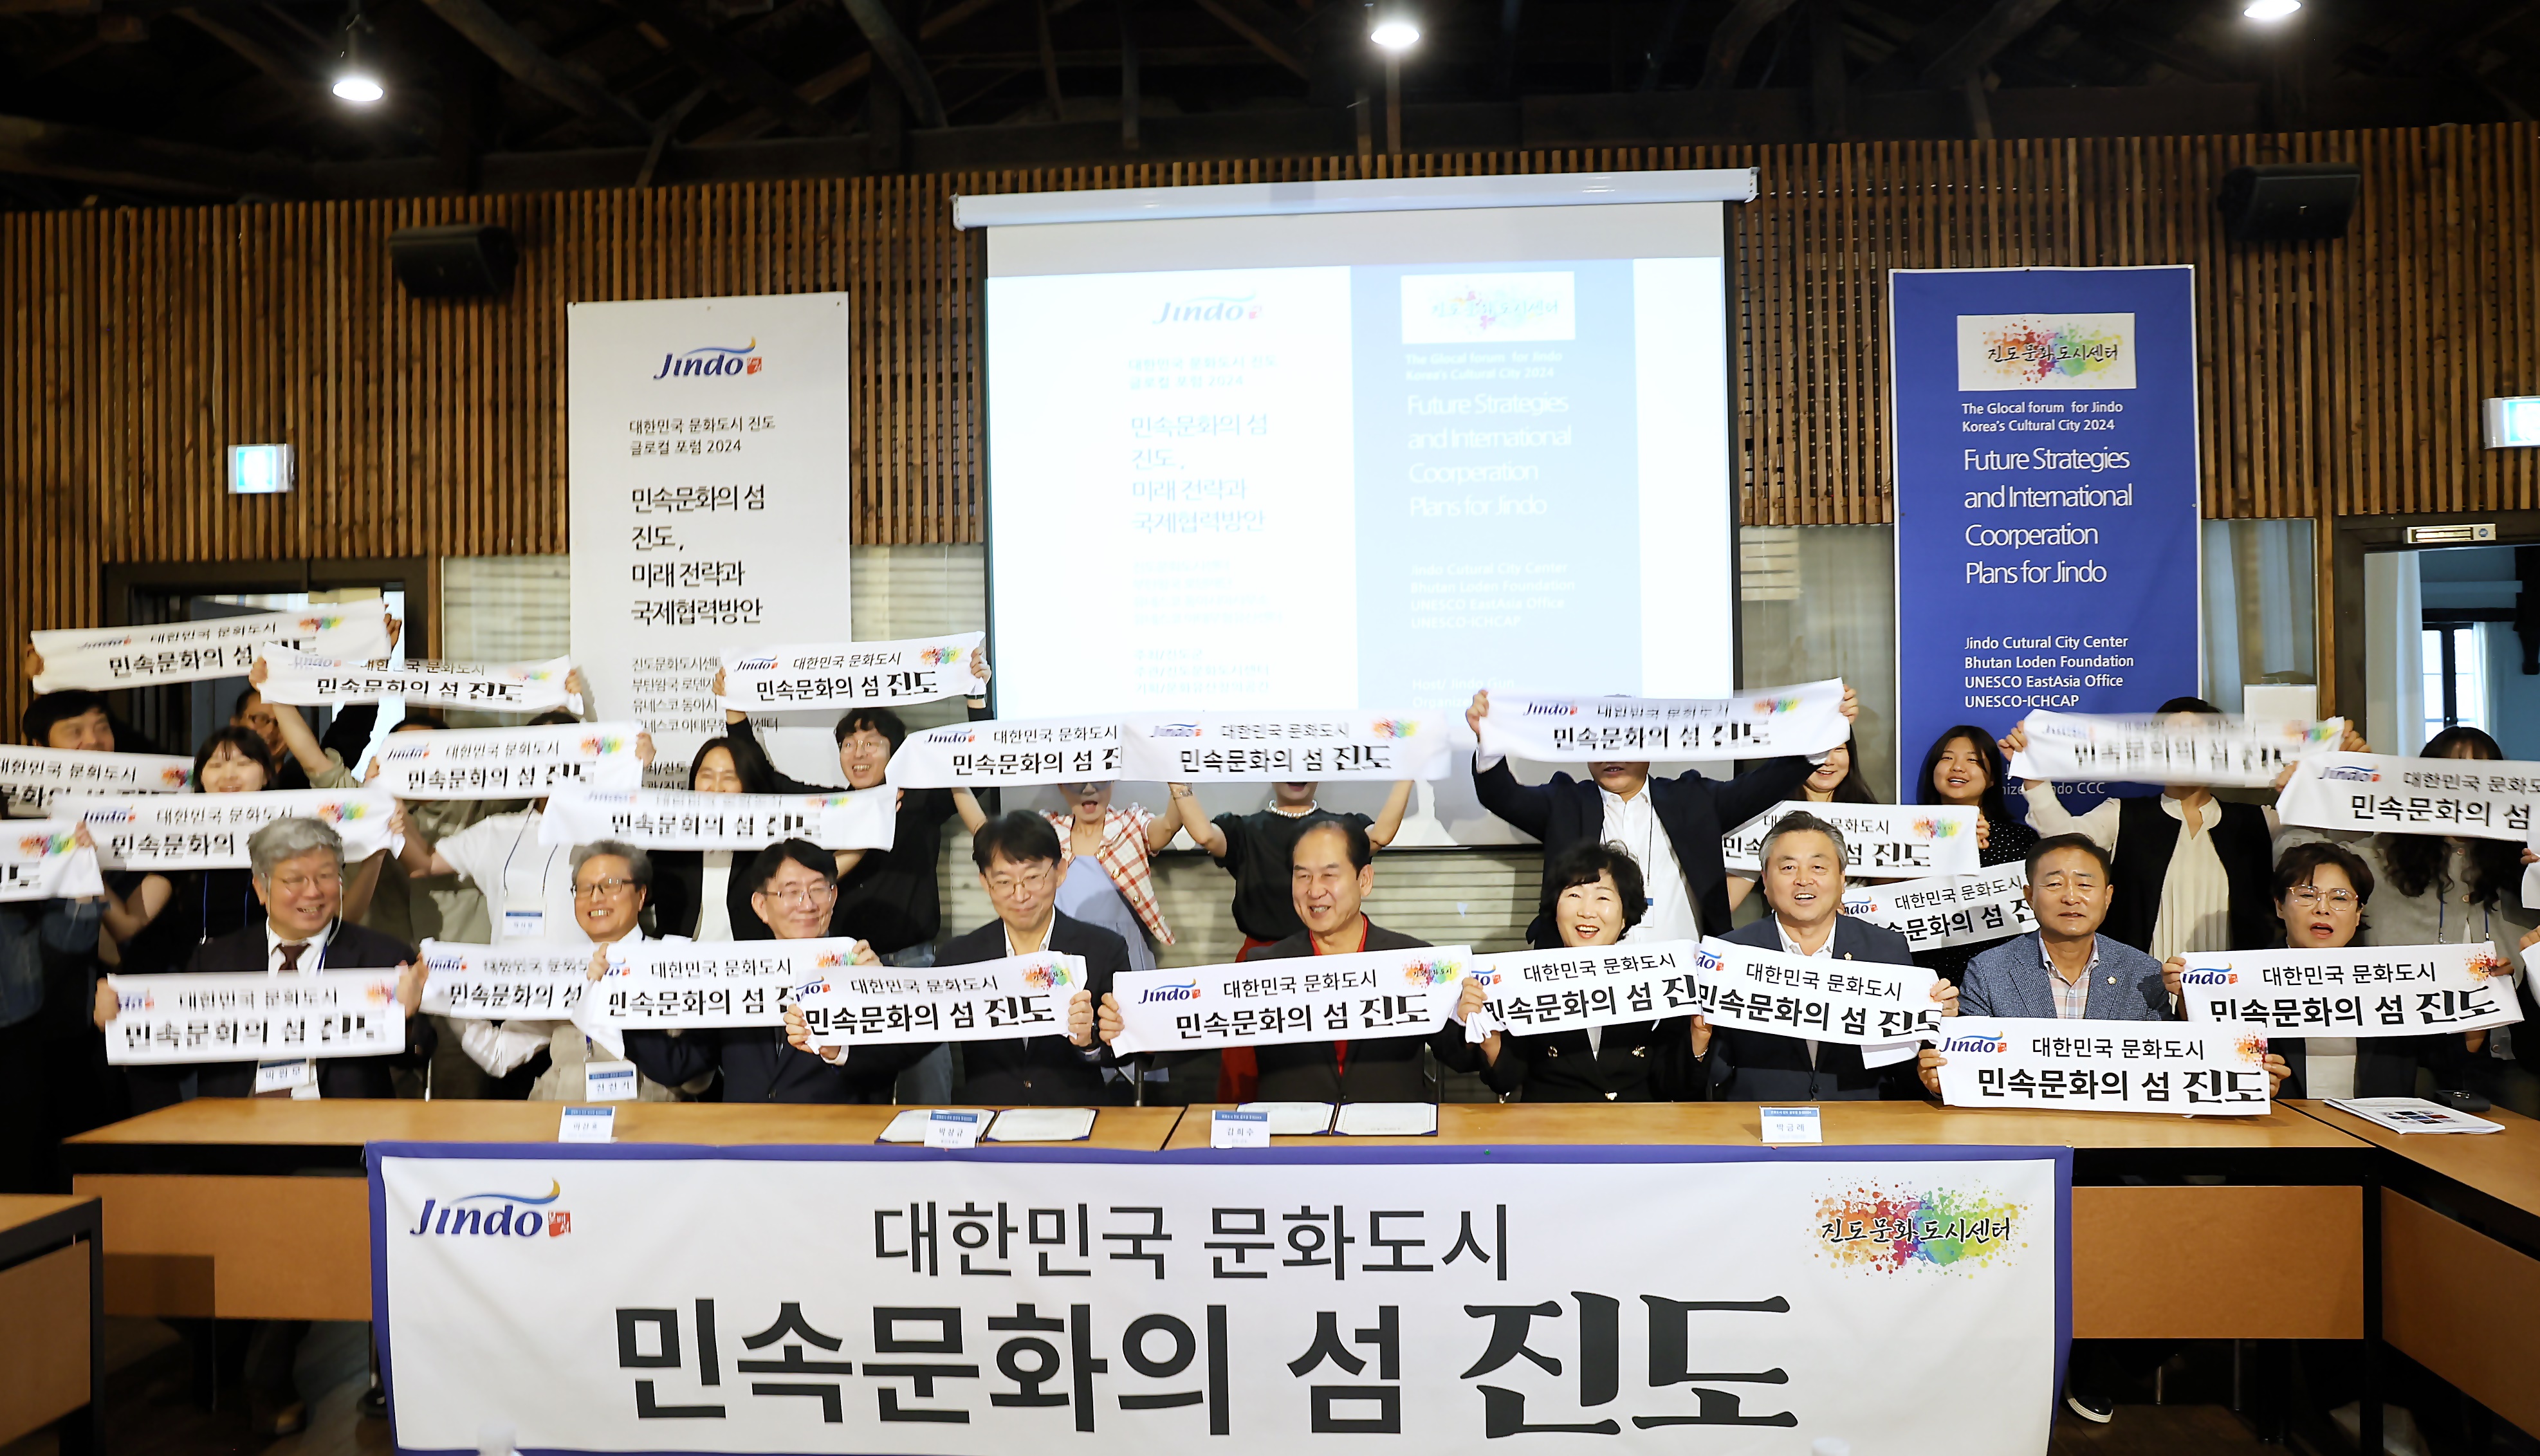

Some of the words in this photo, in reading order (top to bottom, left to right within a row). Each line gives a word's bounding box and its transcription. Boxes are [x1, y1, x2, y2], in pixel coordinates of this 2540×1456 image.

[1152, 302, 1244, 324] Jindo
[1988, 344, 2118, 362] 진도문화도시센터
[653, 353, 744, 380] Jindo
[1407, 394, 1472, 415] Future
[1474, 392, 1569, 416] Strategies
[1962, 403, 1983, 414] The
[1987, 401, 2025, 414] Glocal
[2028, 401, 2065, 413] forum
[2071, 401, 2089, 412] for
[2091, 401, 2123, 413] Jindo
[629, 418, 684, 436] 대한민국
[689, 416, 743, 434] 문화도시
[748, 415, 776, 432] 진도
[1131, 413, 1240, 439] 민속문화의
[1247, 412, 1267, 436] 섬
[1408, 427, 1447, 450] and
[1451, 424, 1572, 448] International
[1962, 420, 2005, 432] Korea's
[2009, 419, 2055, 431] Cultural
[2058, 419, 2081, 433] City
[2083, 419, 2115, 430] 2024
[630, 439, 670, 457] 글로컬
[674, 438, 702, 455] 포럼
[707, 439, 742, 453] 2024
[1964, 449, 2030, 471] Future
[2033, 447, 2131, 473] Strategies
[1409, 461, 1539, 485] Coorperation
[631, 484, 738, 514] 민속문화의
[744, 483, 765, 510] 섬
[1132, 479, 1175, 502] 미래
[1181, 478, 1247, 501] 전략과
[1964, 485, 2005, 508] and
[2009, 483, 2133, 508] International
[1410, 495, 1461, 517] Plans
[1464, 494, 1493, 515] for
[1495, 493, 1547, 515] Jindo
[1132, 510, 1266, 534] 국제협력방안
[1965, 522, 2099, 549] Coorperation
[632, 561, 674, 588] 미래
[679, 560, 746, 587] 전략과
[1966, 560, 2018, 584] Plans
[2020, 559, 2052, 583] for
[2053, 559, 2108, 583] Jindo
[630, 598, 763, 626] 국제협력방안
[1411, 598, 1466, 611] UNESCO
[1964, 636, 1999, 650] Jindo
[2003, 636, 2052, 649] Cutural
[2055, 636, 2080, 650] City
[2083, 636, 2129, 648] Center
[109, 645, 224, 678] 민속문화의
[733, 659, 771, 673] Jindo
[793, 655, 845, 670] 대한민국
[848, 652, 901, 668] 문화도시
[1965, 656, 2012, 669] Bhutan
[2016, 656, 2056, 668] Loden
[2060, 654, 2134, 668] Foundation
[317, 677, 430, 698] 민속문화의
[439, 681, 459, 699] 섬
[469, 683, 524, 703] 진도
[756, 676, 854, 701] 민속문화의
[861, 674, 879, 697] 섬
[887, 670, 939, 697] 진도
[1965, 676, 2022, 688] UNESCO
[2027, 675, 2081, 688] EastAsia
[2084, 674, 2124, 687] Office
[1523, 701, 1569, 717] Jindo
[1965, 695, 2079, 708] UNESCO-ICHCAP
[924, 732, 966, 744] Jindo
[993, 727, 1053, 745] 대한민국
[1058, 724, 1118, 742] 문화도시
[1220, 723, 1284, 740] 대한민국
[1287, 721, 1350, 739] 문화도시
[1553, 725, 1670, 751] 민속문화의
[1680, 723, 1700, 750] 섬
[1710, 719, 1771, 750] 진도
[953, 750, 1063, 776] 민속문화의
[1072, 748, 1092, 772] 섬
[1180, 748, 1293, 773] 민속문화의
[1302, 747, 1323, 772] 섬
[1332, 744, 1392, 771] 진도
[408, 766, 508, 792] 민속문화의
[2077, 782, 2105, 795] CCC
[2404, 771, 2481, 792] 대한민국
[2351, 795, 2492, 827] 민속문화의
[2503, 804, 2532, 830] 섬
[1830, 818, 1890, 835] 문화도시
[111, 833, 235, 860] 민속문화의
[1872, 841, 1931, 868] 진도
[1895, 888, 1956, 911] 대한민국
[1960, 874, 2023, 901] 문화도시
[1981, 903, 2005, 929] 섬
[651, 959, 718, 980] 대한민국
[725, 957, 791, 977] 문화도시
[1523, 961, 1596, 983] 대한민국
[1603, 953, 1676, 975] 문화도시
[2263, 964, 2345, 987] 대한민국
[2352, 962, 2436, 984] 문화도시
[851, 979, 921, 995] 대한민국
[926, 975, 999, 994] 문화도시
[1138, 984, 1190, 1005] Jindo
[1224, 977, 1296, 1000] 대한민국
[1304, 969, 1377, 992] 문화도시
[1746, 963, 1820, 990] 대한민국
[1827, 973, 1902, 1002] 문화도시
[609, 988, 730, 1017] 민속문화의
[742, 988, 764, 1014] 섬
[805, 1001, 939, 1037] 민속문화의
[950, 1002, 975, 1029] 섬
[984, 993, 1056, 1028] 진도
[1483, 986, 1617, 1026] 민속문화의
[1626, 982, 1652, 1012] 섬
[1697, 984, 1830, 1031] 민속문화의
[1841, 1006, 1866, 1036] 섬
[2210, 996, 2364, 1028] 민속문화의
[2375, 995, 2404, 1025] 섬
[2416, 985, 2501, 1024] 진도
[1177, 1004, 1312, 1040] 민속문화의
[1323, 1002, 1348, 1030] 섬
[1359, 992, 1431, 1028] 진도
[1939, 1037, 1996, 1054] Jindo
[2032, 1037, 2113, 1059] 대한민국
[2122, 1038, 2205, 1061] 문화도시
[1978, 1067, 2128, 1101] 민속문화의
[2141, 1071, 2169, 1101] 섬
[2183, 1069, 2267, 1103] 진도
[410, 1197, 543, 1237] Jindo
[873, 1201, 1173, 1280] 대한민국
[1203, 1203, 1509, 1282] 문화도시
[1821, 1217, 2011, 1244] 진도문화도시센터
[615, 1297, 1231, 1437] 민속문화의
[1286, 1304, 1401, 1435] 섬
[1459, 1291, 1799, 1439] 진도
